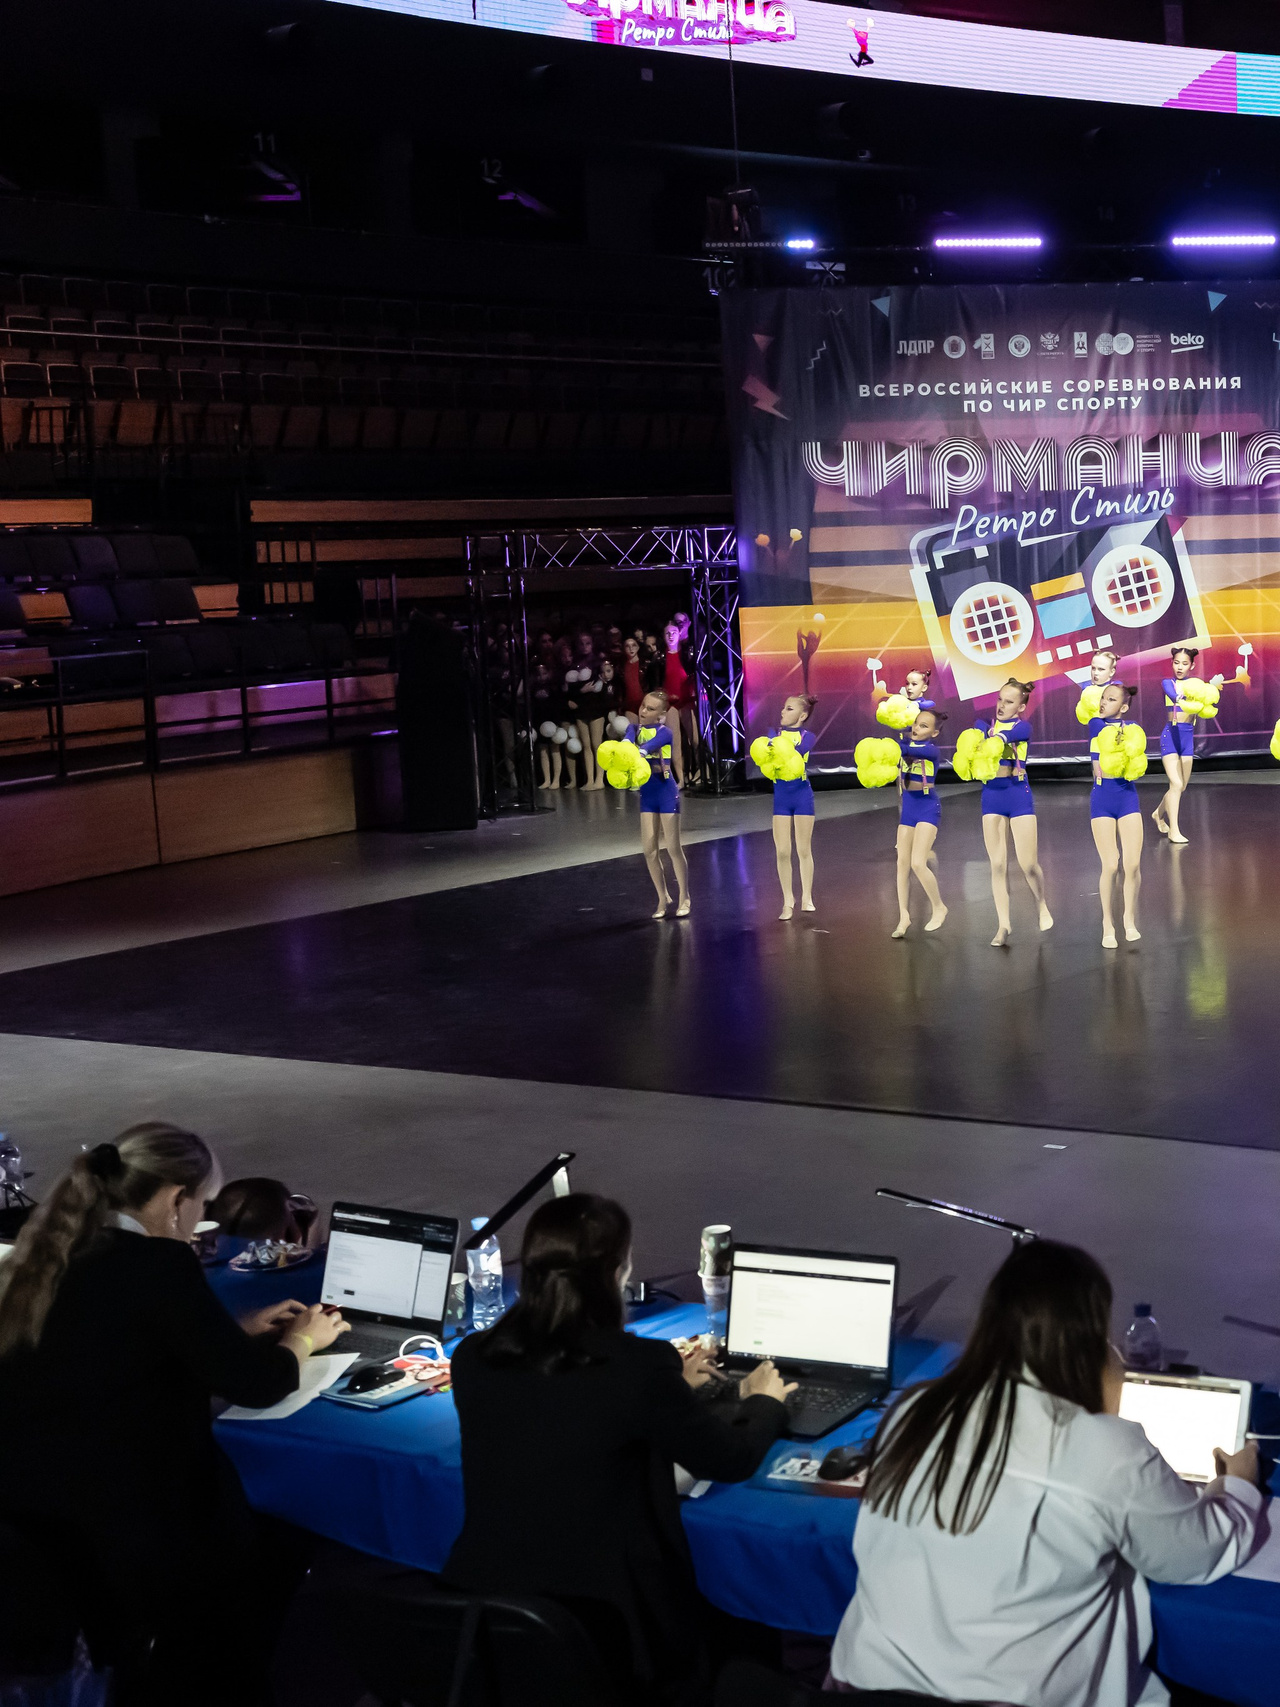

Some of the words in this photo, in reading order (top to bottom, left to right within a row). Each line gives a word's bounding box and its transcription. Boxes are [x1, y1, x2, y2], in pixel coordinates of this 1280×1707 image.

[622, 18, 675, 46] Ретро
[897, 340, 935, 356] ЛДПР
[1170, 333, 1205, 345] beko
[858, 376, 1054, 398] ВСЕРОССИЙСКИЕ
[1062, 375, 1243, 393] СОРЕВНОВАНИЯ
[963, 397, 994, 414] ПО
[1002, 397, 1047, 413] ЧИР
[1056, 395, 1144, 412] СПОРТУ
[951, 504, 1058, 546] Ретро
[1069, 485, 1175, 526] Стиль
